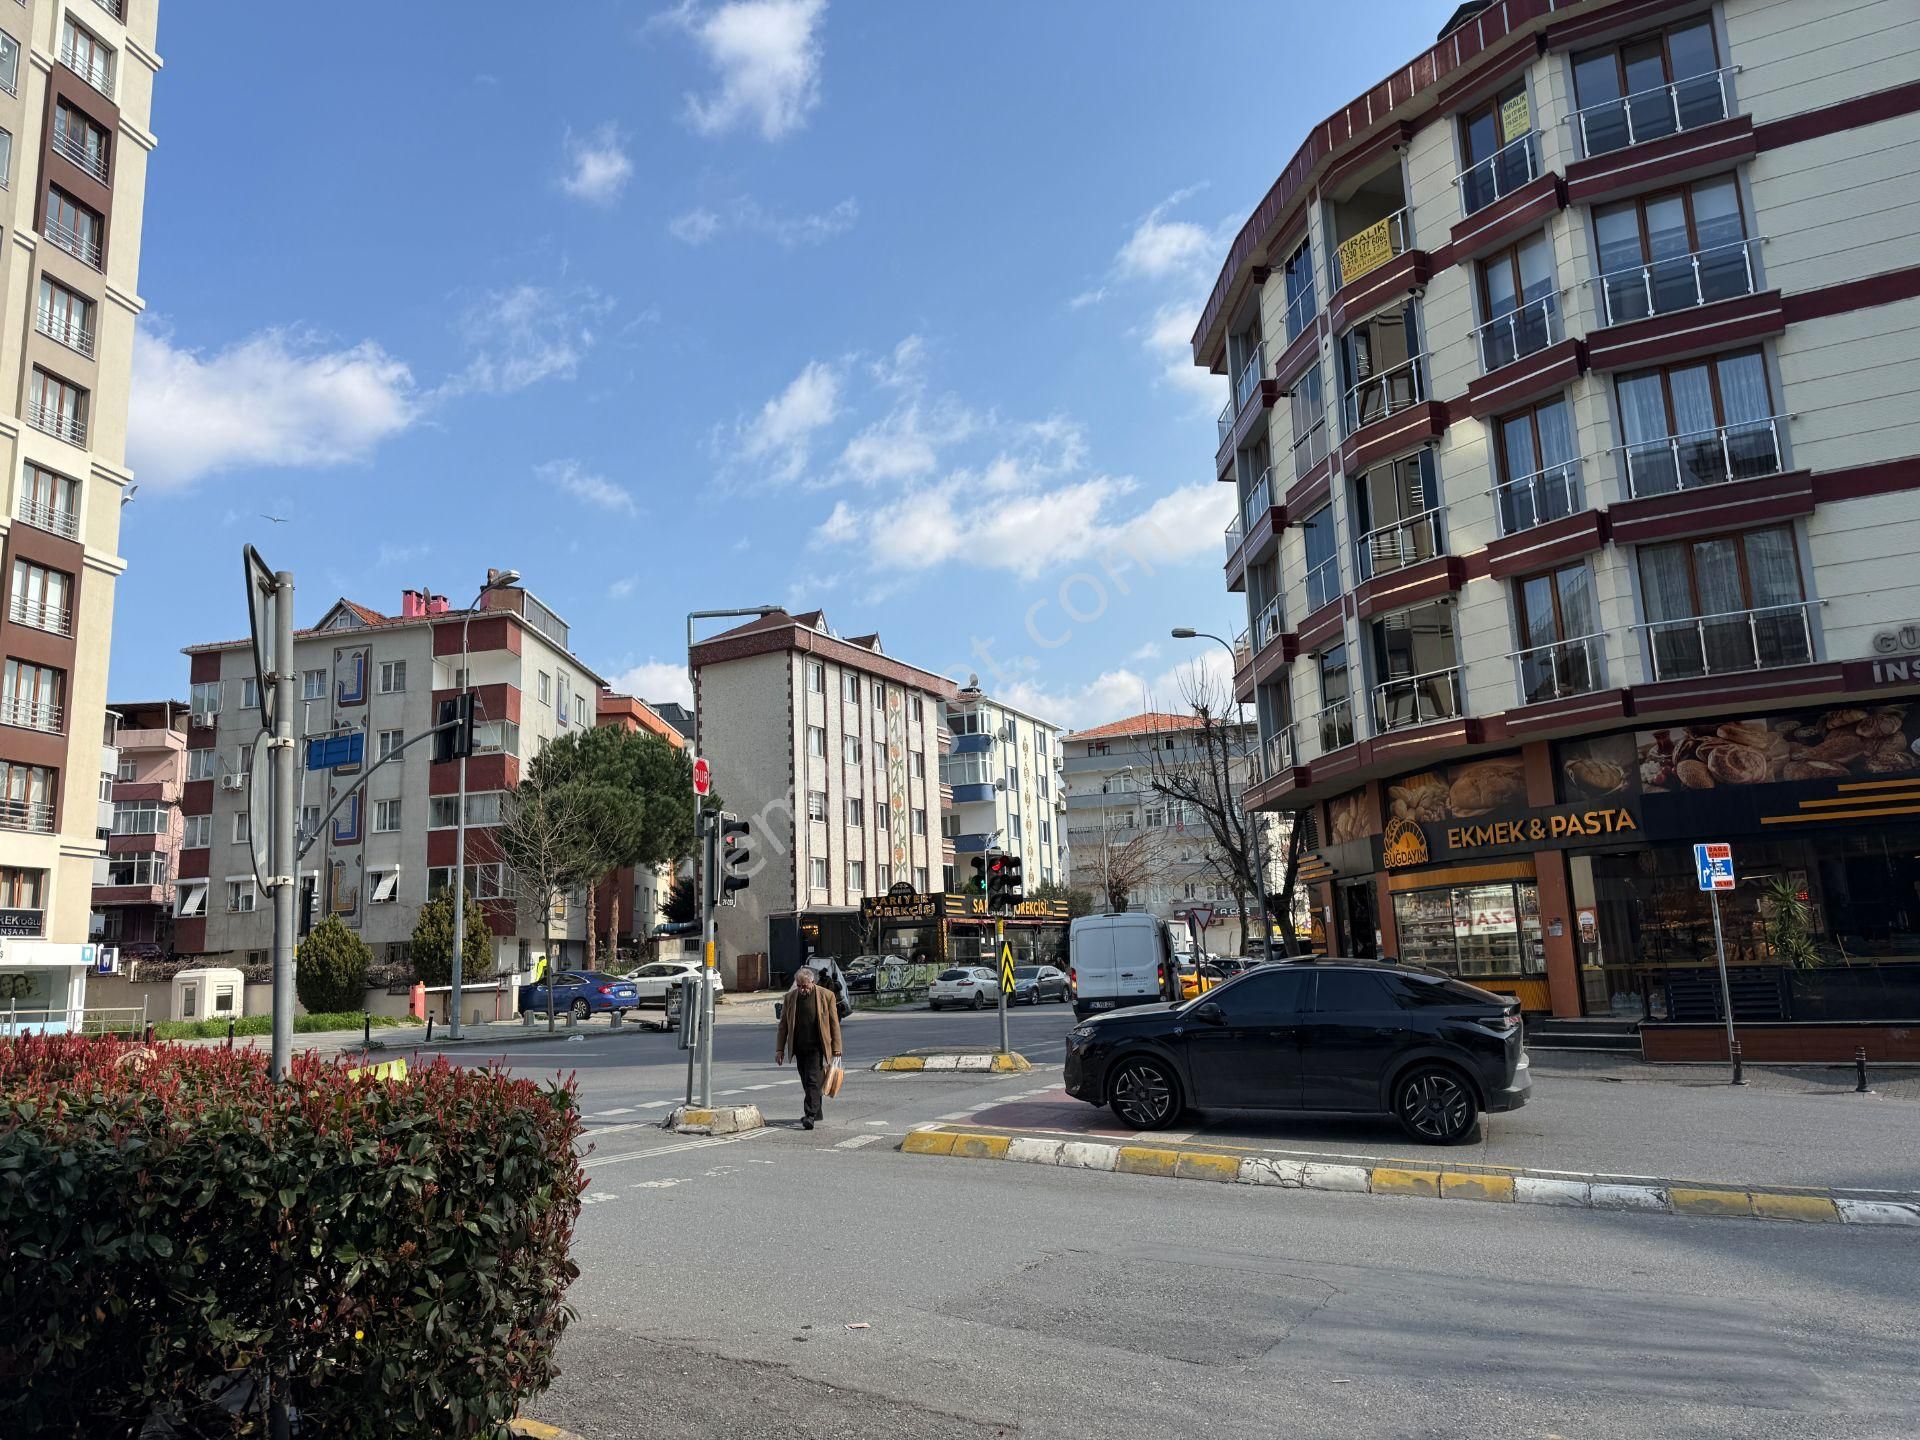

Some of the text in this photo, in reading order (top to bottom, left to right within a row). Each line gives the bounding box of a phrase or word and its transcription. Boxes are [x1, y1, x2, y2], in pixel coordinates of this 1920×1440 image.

[695, 770, 708, 785] DUR
[1447, 807, 1637, 849] EKMEK & PASTA
[1384, 848, 1428, 867] BUĞDAYIM
